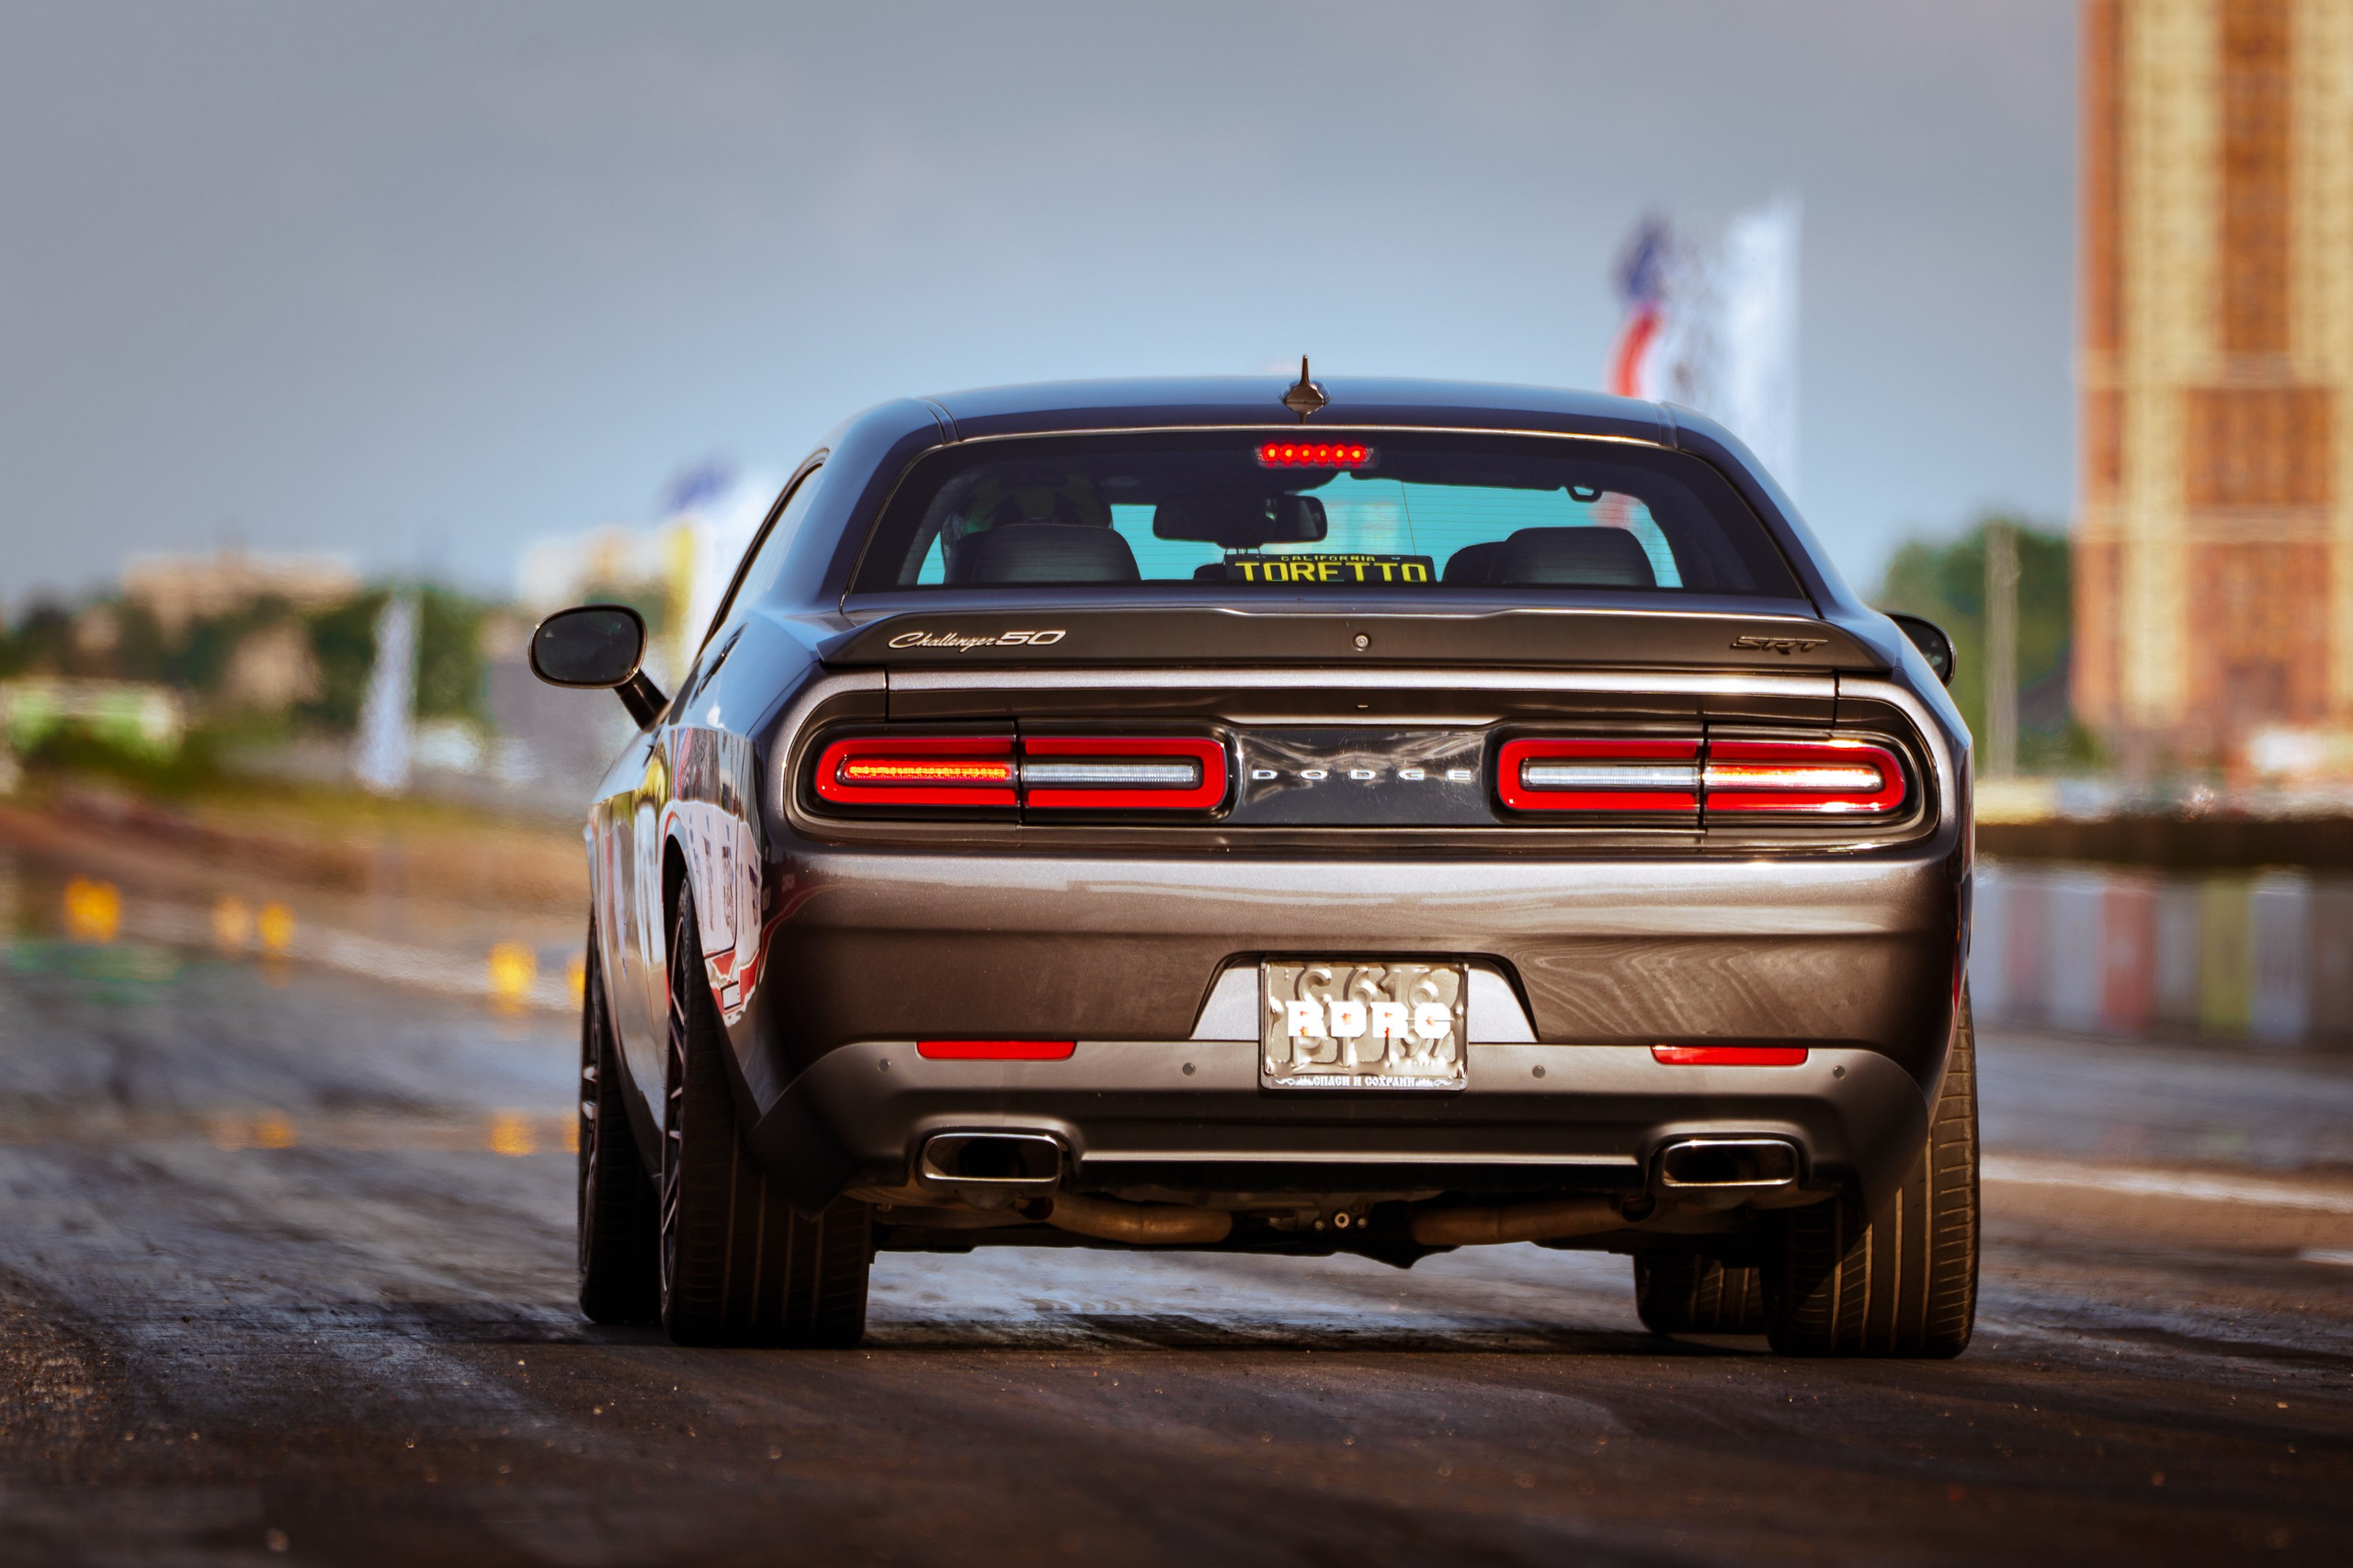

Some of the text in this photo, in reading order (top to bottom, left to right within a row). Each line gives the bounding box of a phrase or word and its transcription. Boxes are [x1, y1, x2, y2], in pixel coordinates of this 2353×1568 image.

[1234, 561, 1427, 582] TORETTO
[995, 630, 1066, 645] 50
[1731, 636, 1829, 653] SRT
[1251, 768, 1472, 781] DODGE
[1313, 1075, 1416, 1087] СПАСИ И СОХРАНИ
